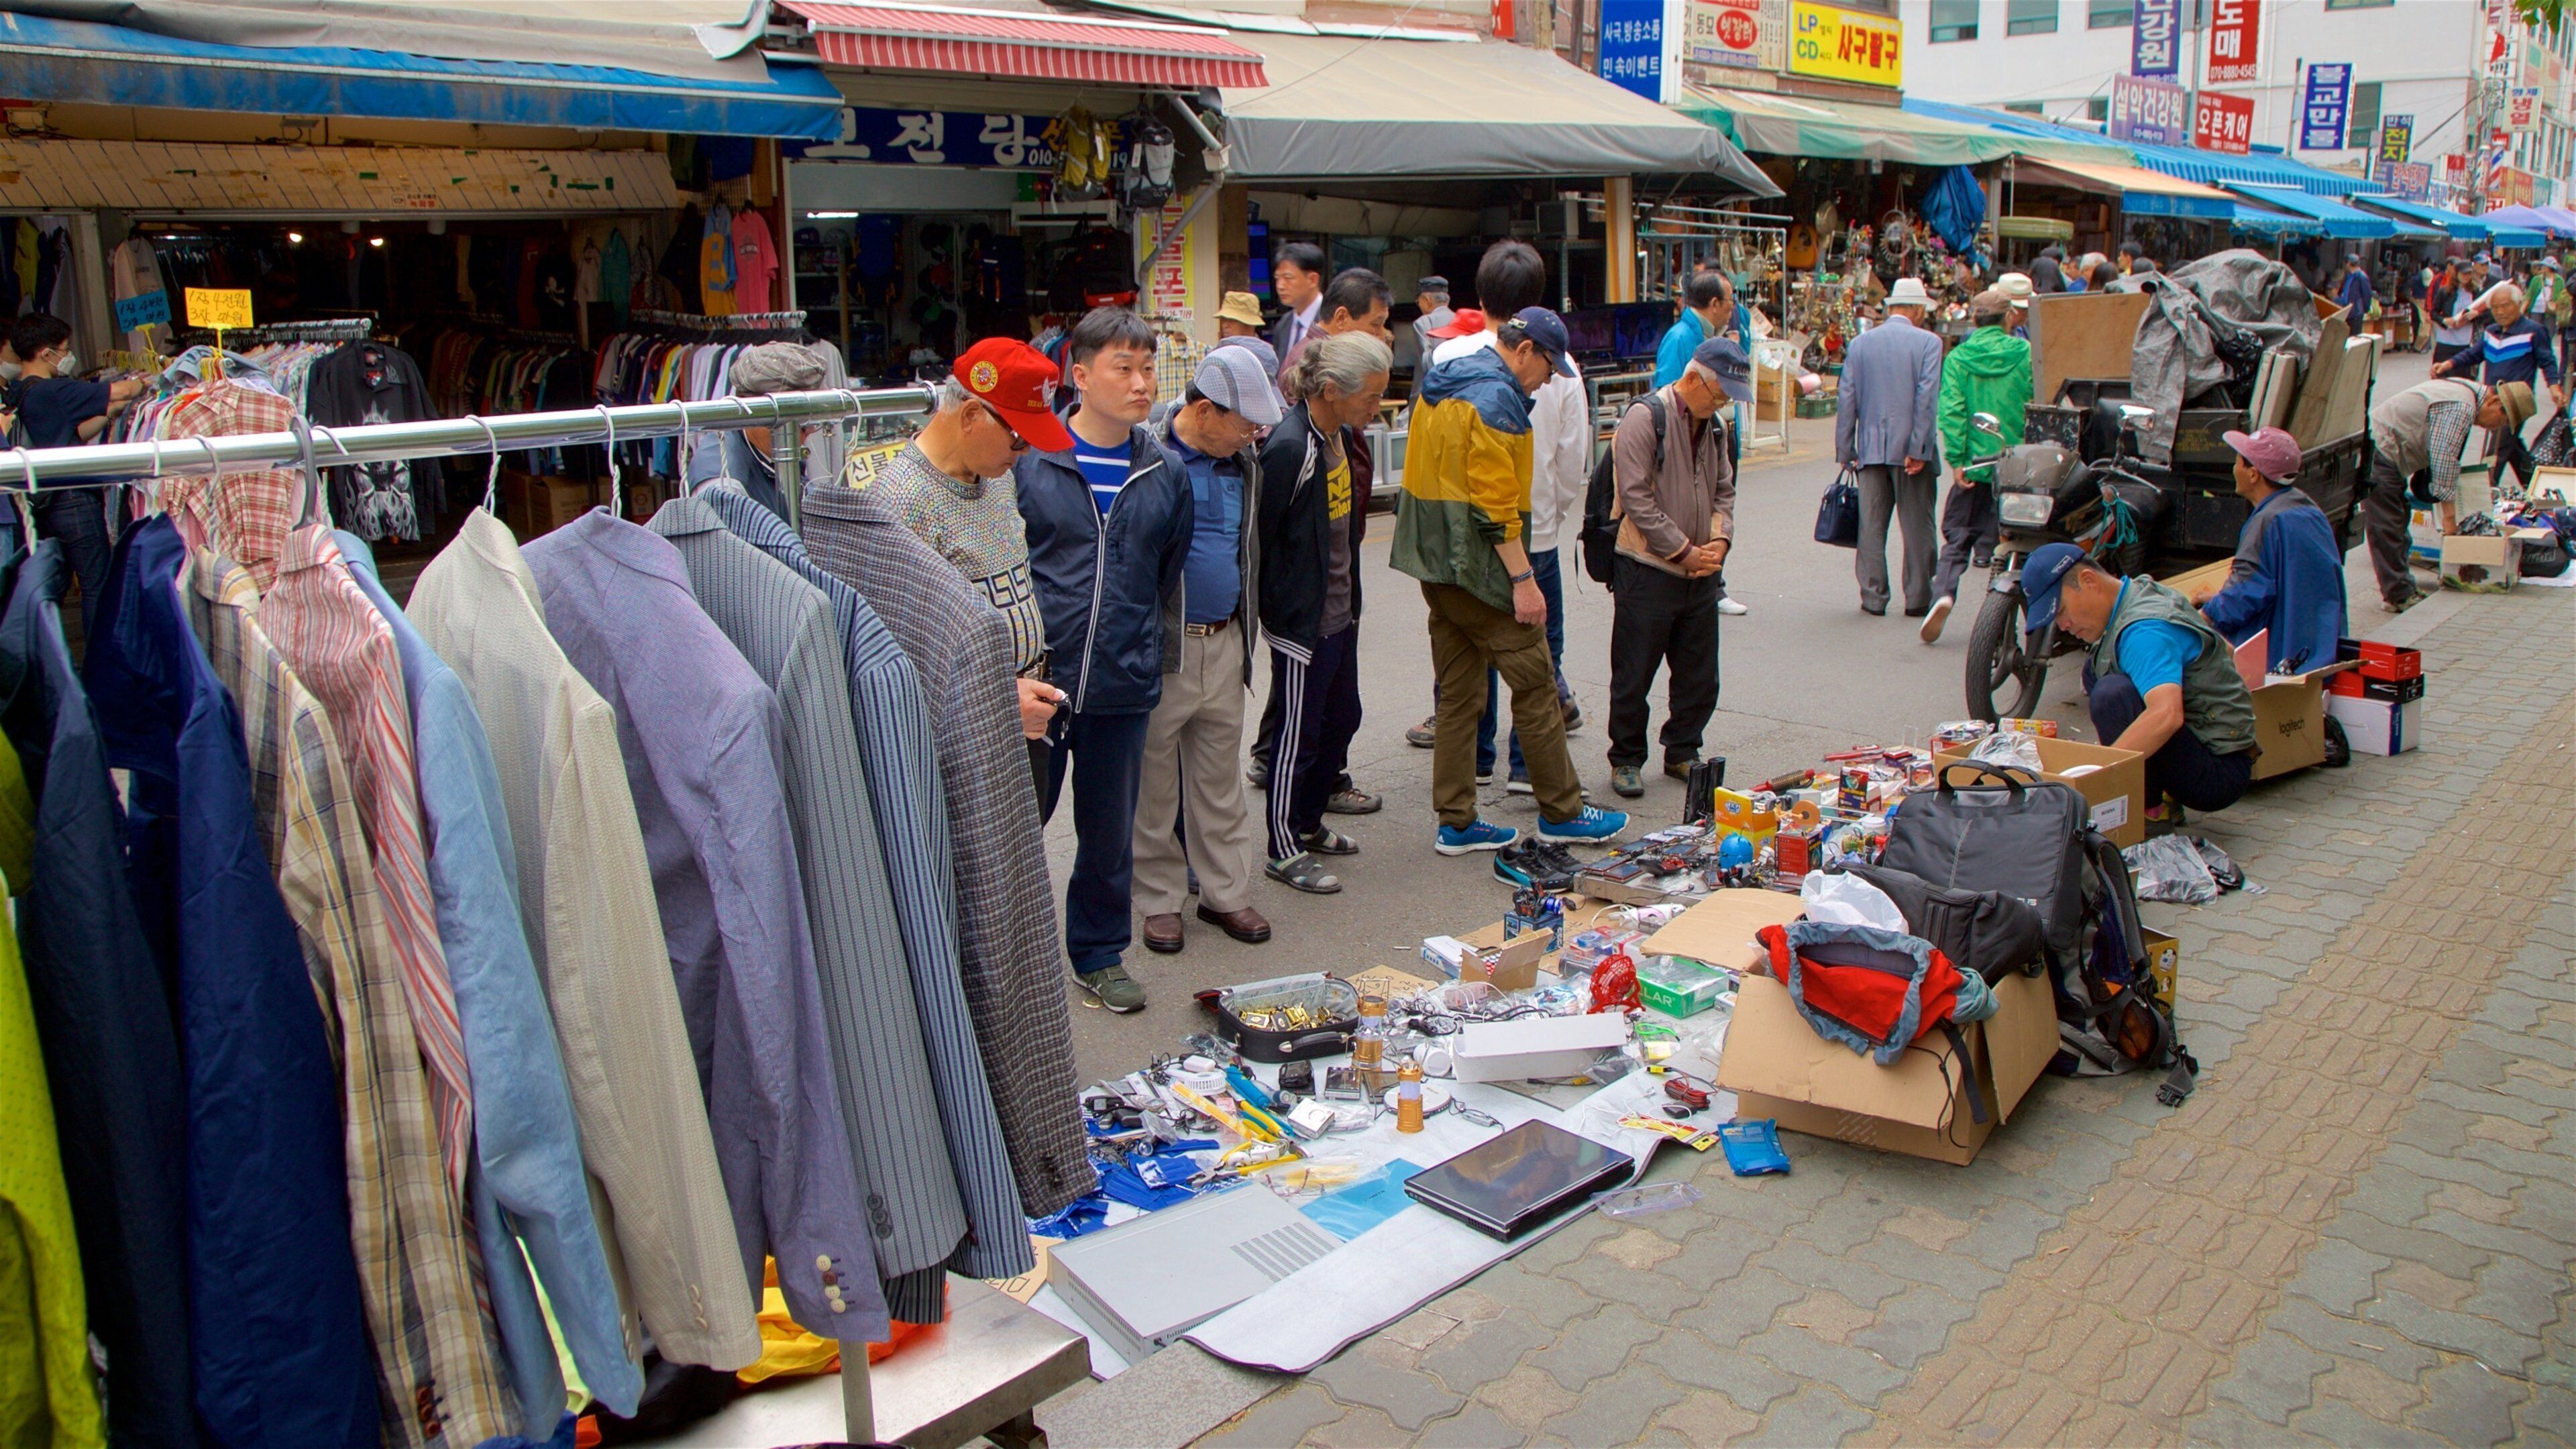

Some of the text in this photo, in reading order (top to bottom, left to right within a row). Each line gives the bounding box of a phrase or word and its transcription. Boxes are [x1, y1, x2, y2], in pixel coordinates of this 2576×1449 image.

[1799, 13, 1818, 33] LP
[1796, 39, 1819, 60] CD
[1603, 54, 1660, 78] 민속이벤트
[2115, 81, 2184, 128] 설악건강원
[2198, 108, 2248, 142] 오픈케어
[2279, 715, 2305, 737] logitech
[1639, 987, 1672, 1008] LAR
